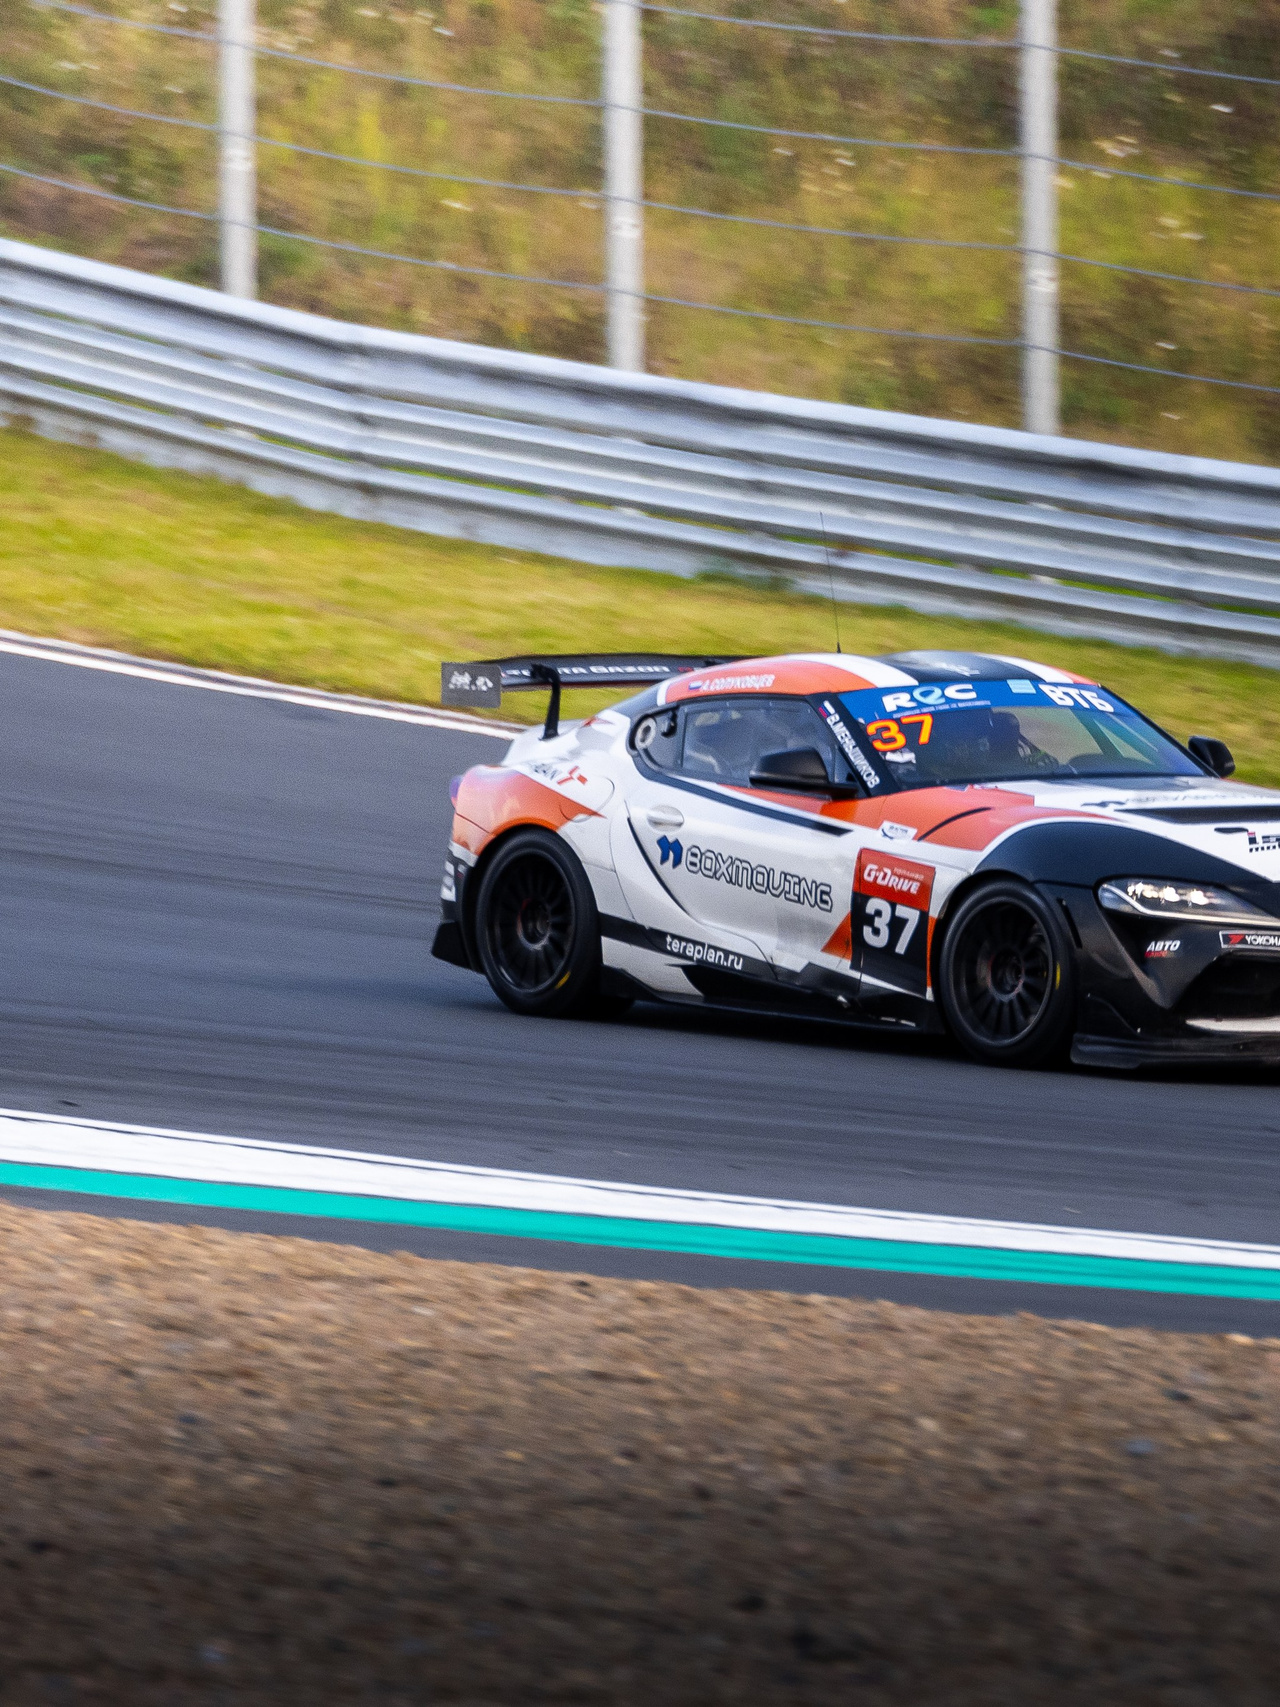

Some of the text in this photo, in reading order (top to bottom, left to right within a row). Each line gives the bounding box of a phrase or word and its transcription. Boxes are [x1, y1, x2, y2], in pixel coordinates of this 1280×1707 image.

[866, 713, 933, 752] 37
[685, 845, 833, 913] BOXMOVING
[863, 897, 920, 955] 37
[665, 934, 744, 971] teraplan.ru
